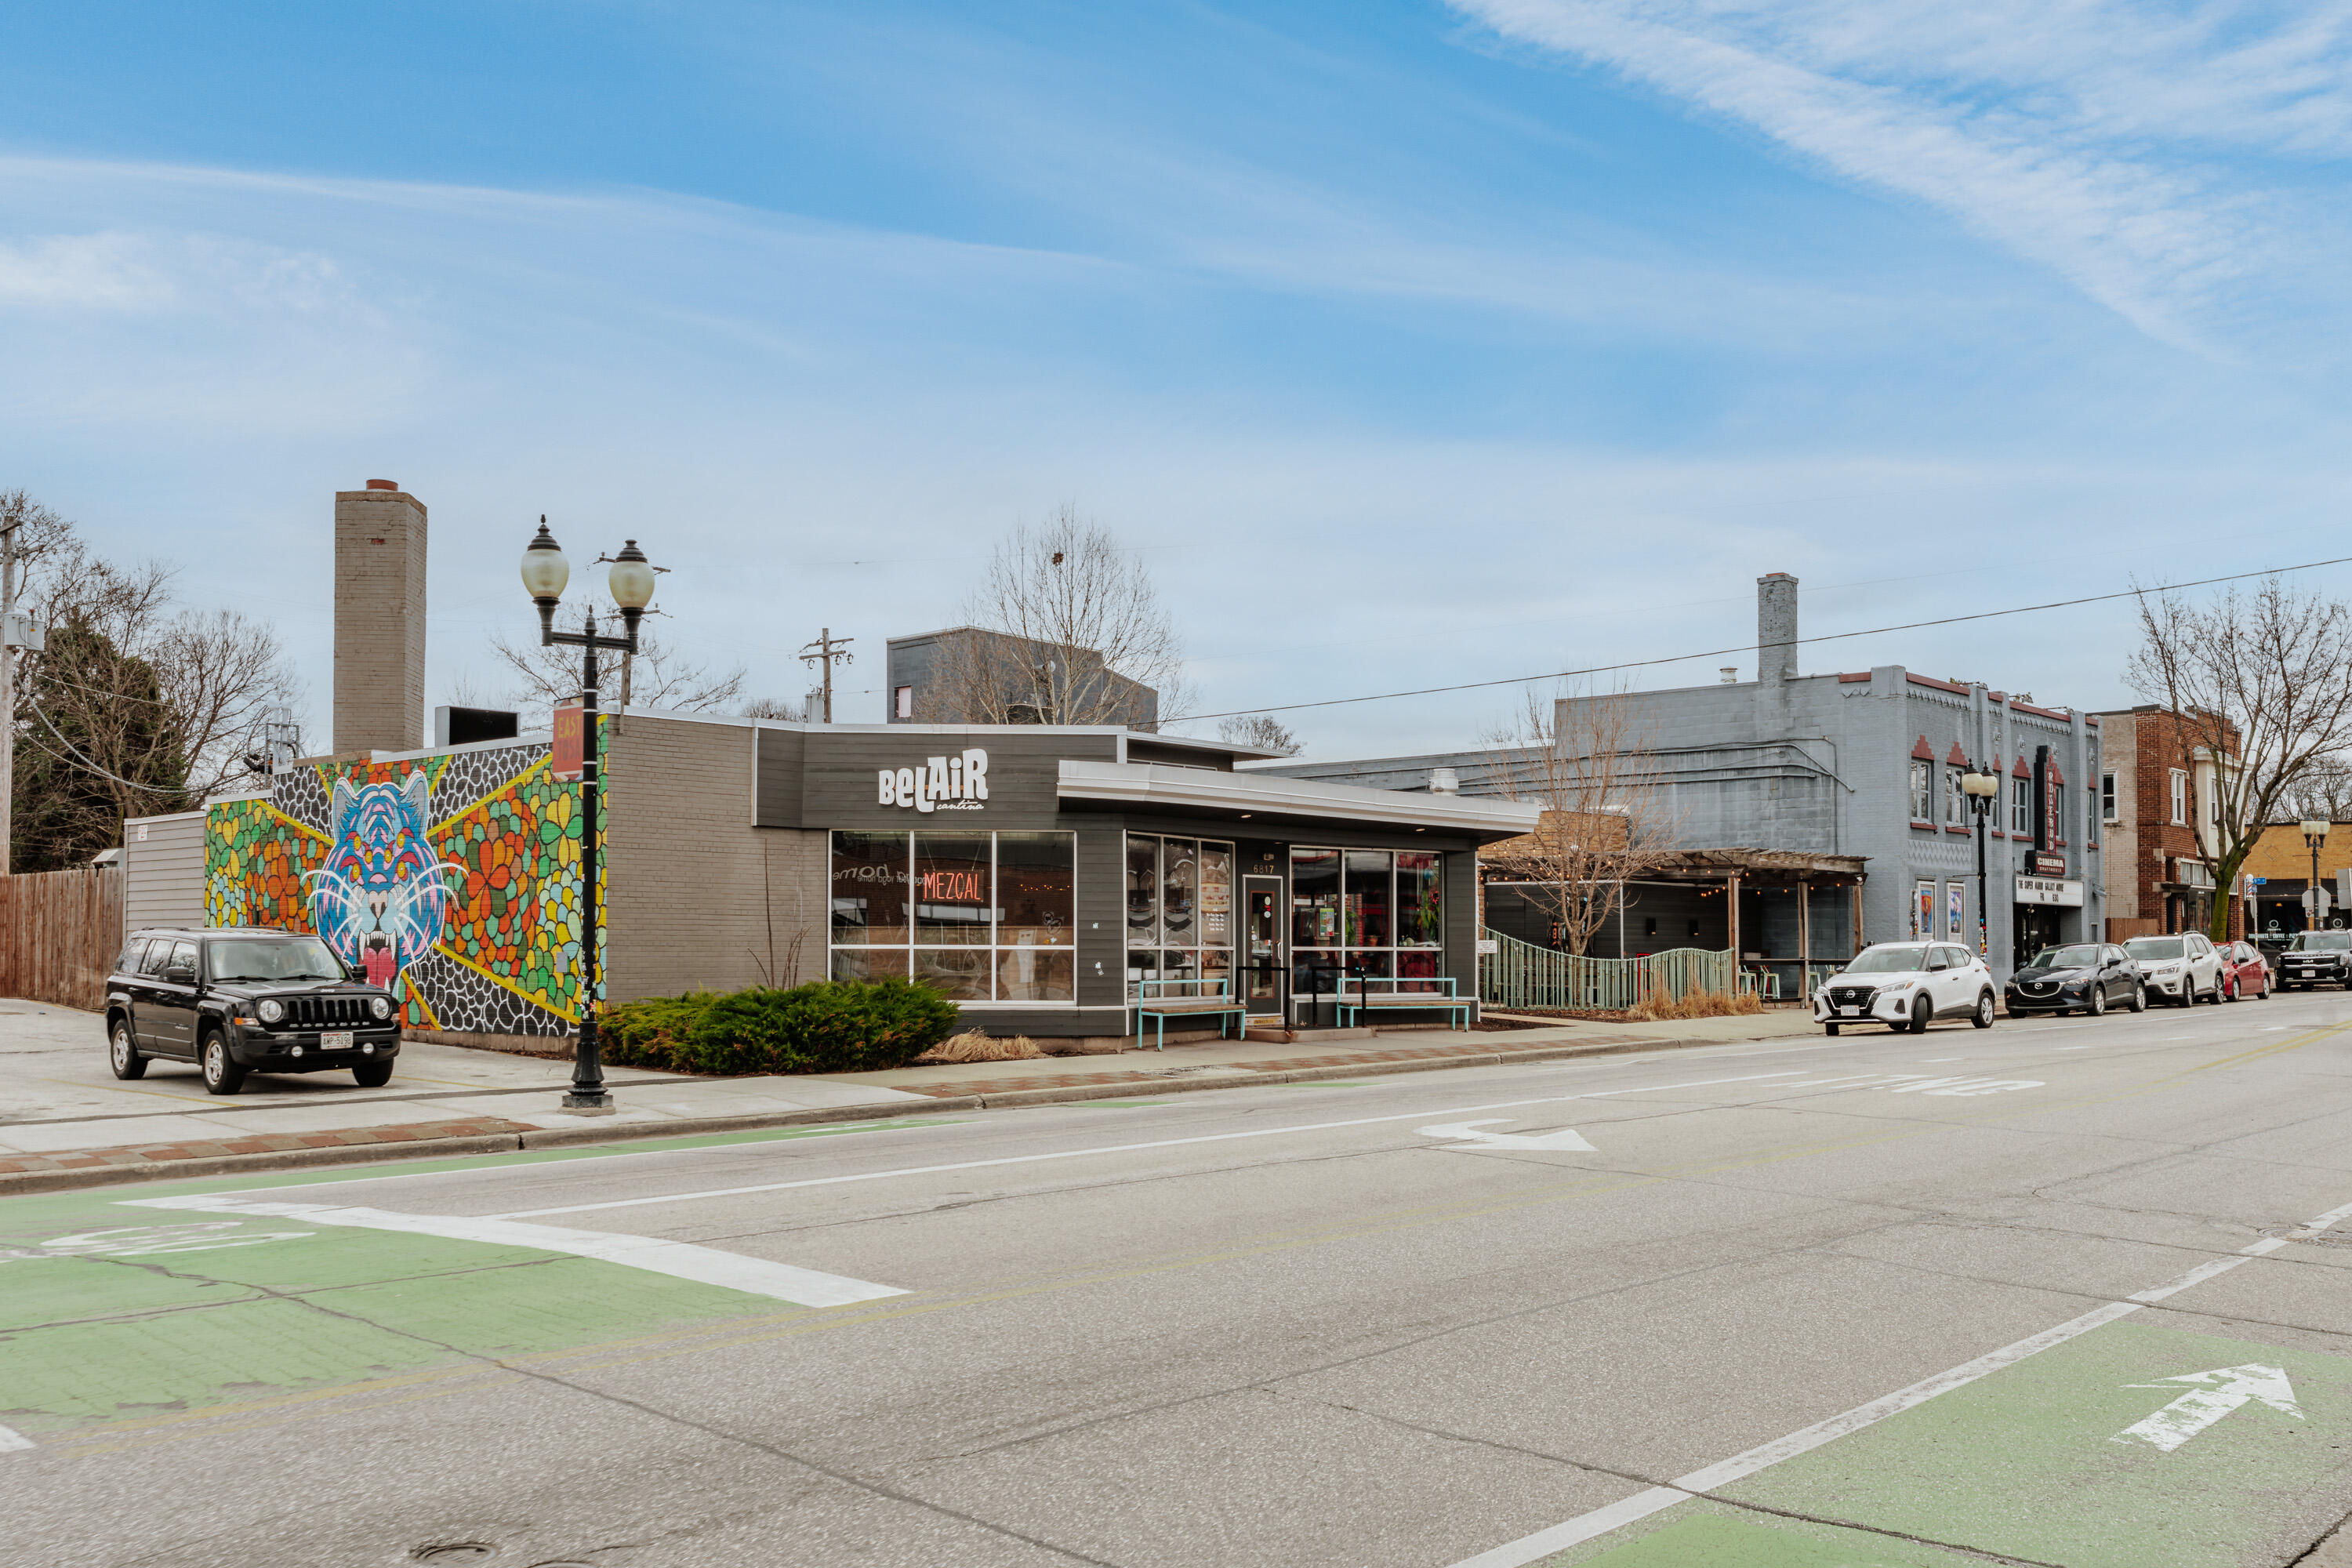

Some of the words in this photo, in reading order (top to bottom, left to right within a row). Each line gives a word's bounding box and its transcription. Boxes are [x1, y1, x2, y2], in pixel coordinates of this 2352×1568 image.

[557, 715, 581, 739] EAST
[557, 739, 581, 761] TOSA
[936, 799, 985, 811] cantina
[1253, 864, 1274, 874] 6817
[2038, 857, 2063, 867] CINEMA
[924, 871, 982, 900] MEZCAL
